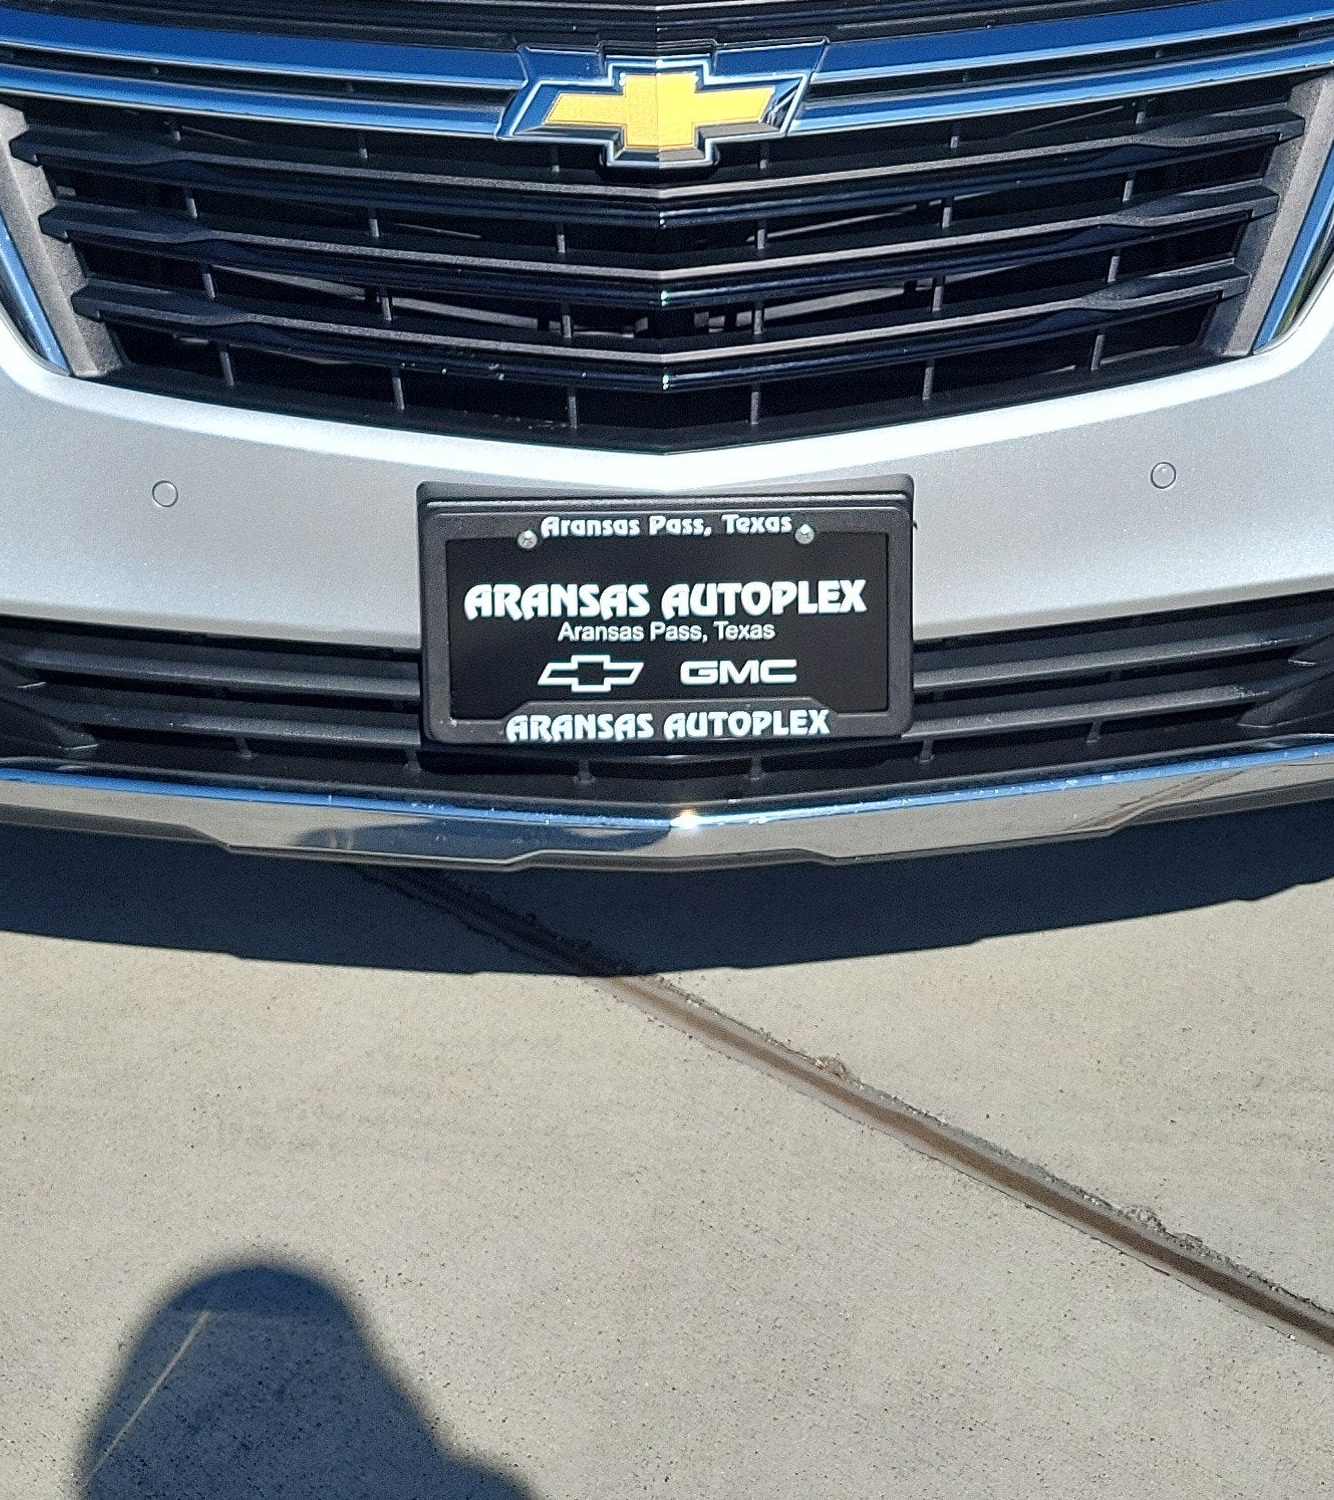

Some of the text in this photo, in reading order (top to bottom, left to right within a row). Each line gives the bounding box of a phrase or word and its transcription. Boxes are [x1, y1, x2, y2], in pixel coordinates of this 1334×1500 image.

[540, 513, 793, 539] Aransas Pass, Texas
[464, 578, 868, 621] ARANSAS AUTOPLEX
[557, 620, 777, 643] Aransas Pass, Texas
[680, 659, 798, 686] GMC
[505, 709, 831, 743] ARANSAS AUTOPLEX
